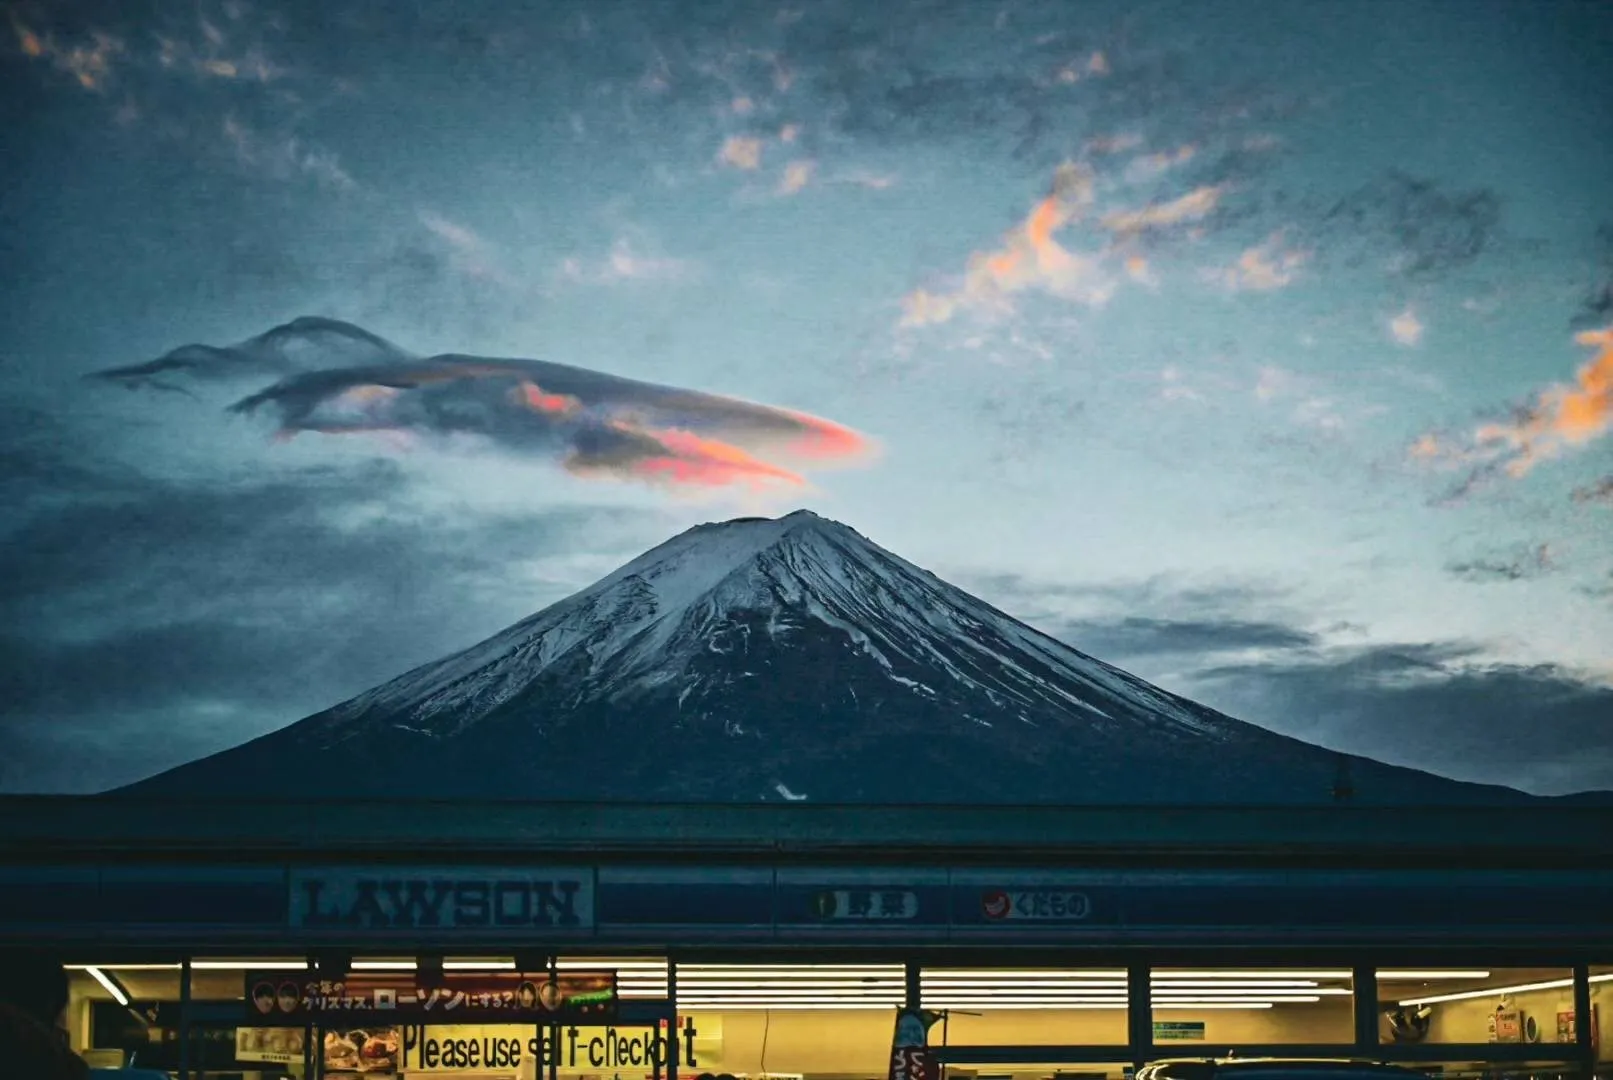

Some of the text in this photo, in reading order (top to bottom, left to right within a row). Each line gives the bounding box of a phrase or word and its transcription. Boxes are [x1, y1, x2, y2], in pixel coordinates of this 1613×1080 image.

[302, 880, 581, 925] LAWSON
[847, 892, 907, 917] 野菜
[1014, 893, 1086, 916] くだもの
[402, 1023, 480, 1069] Please
[483, 1037, 521, 1069] use
